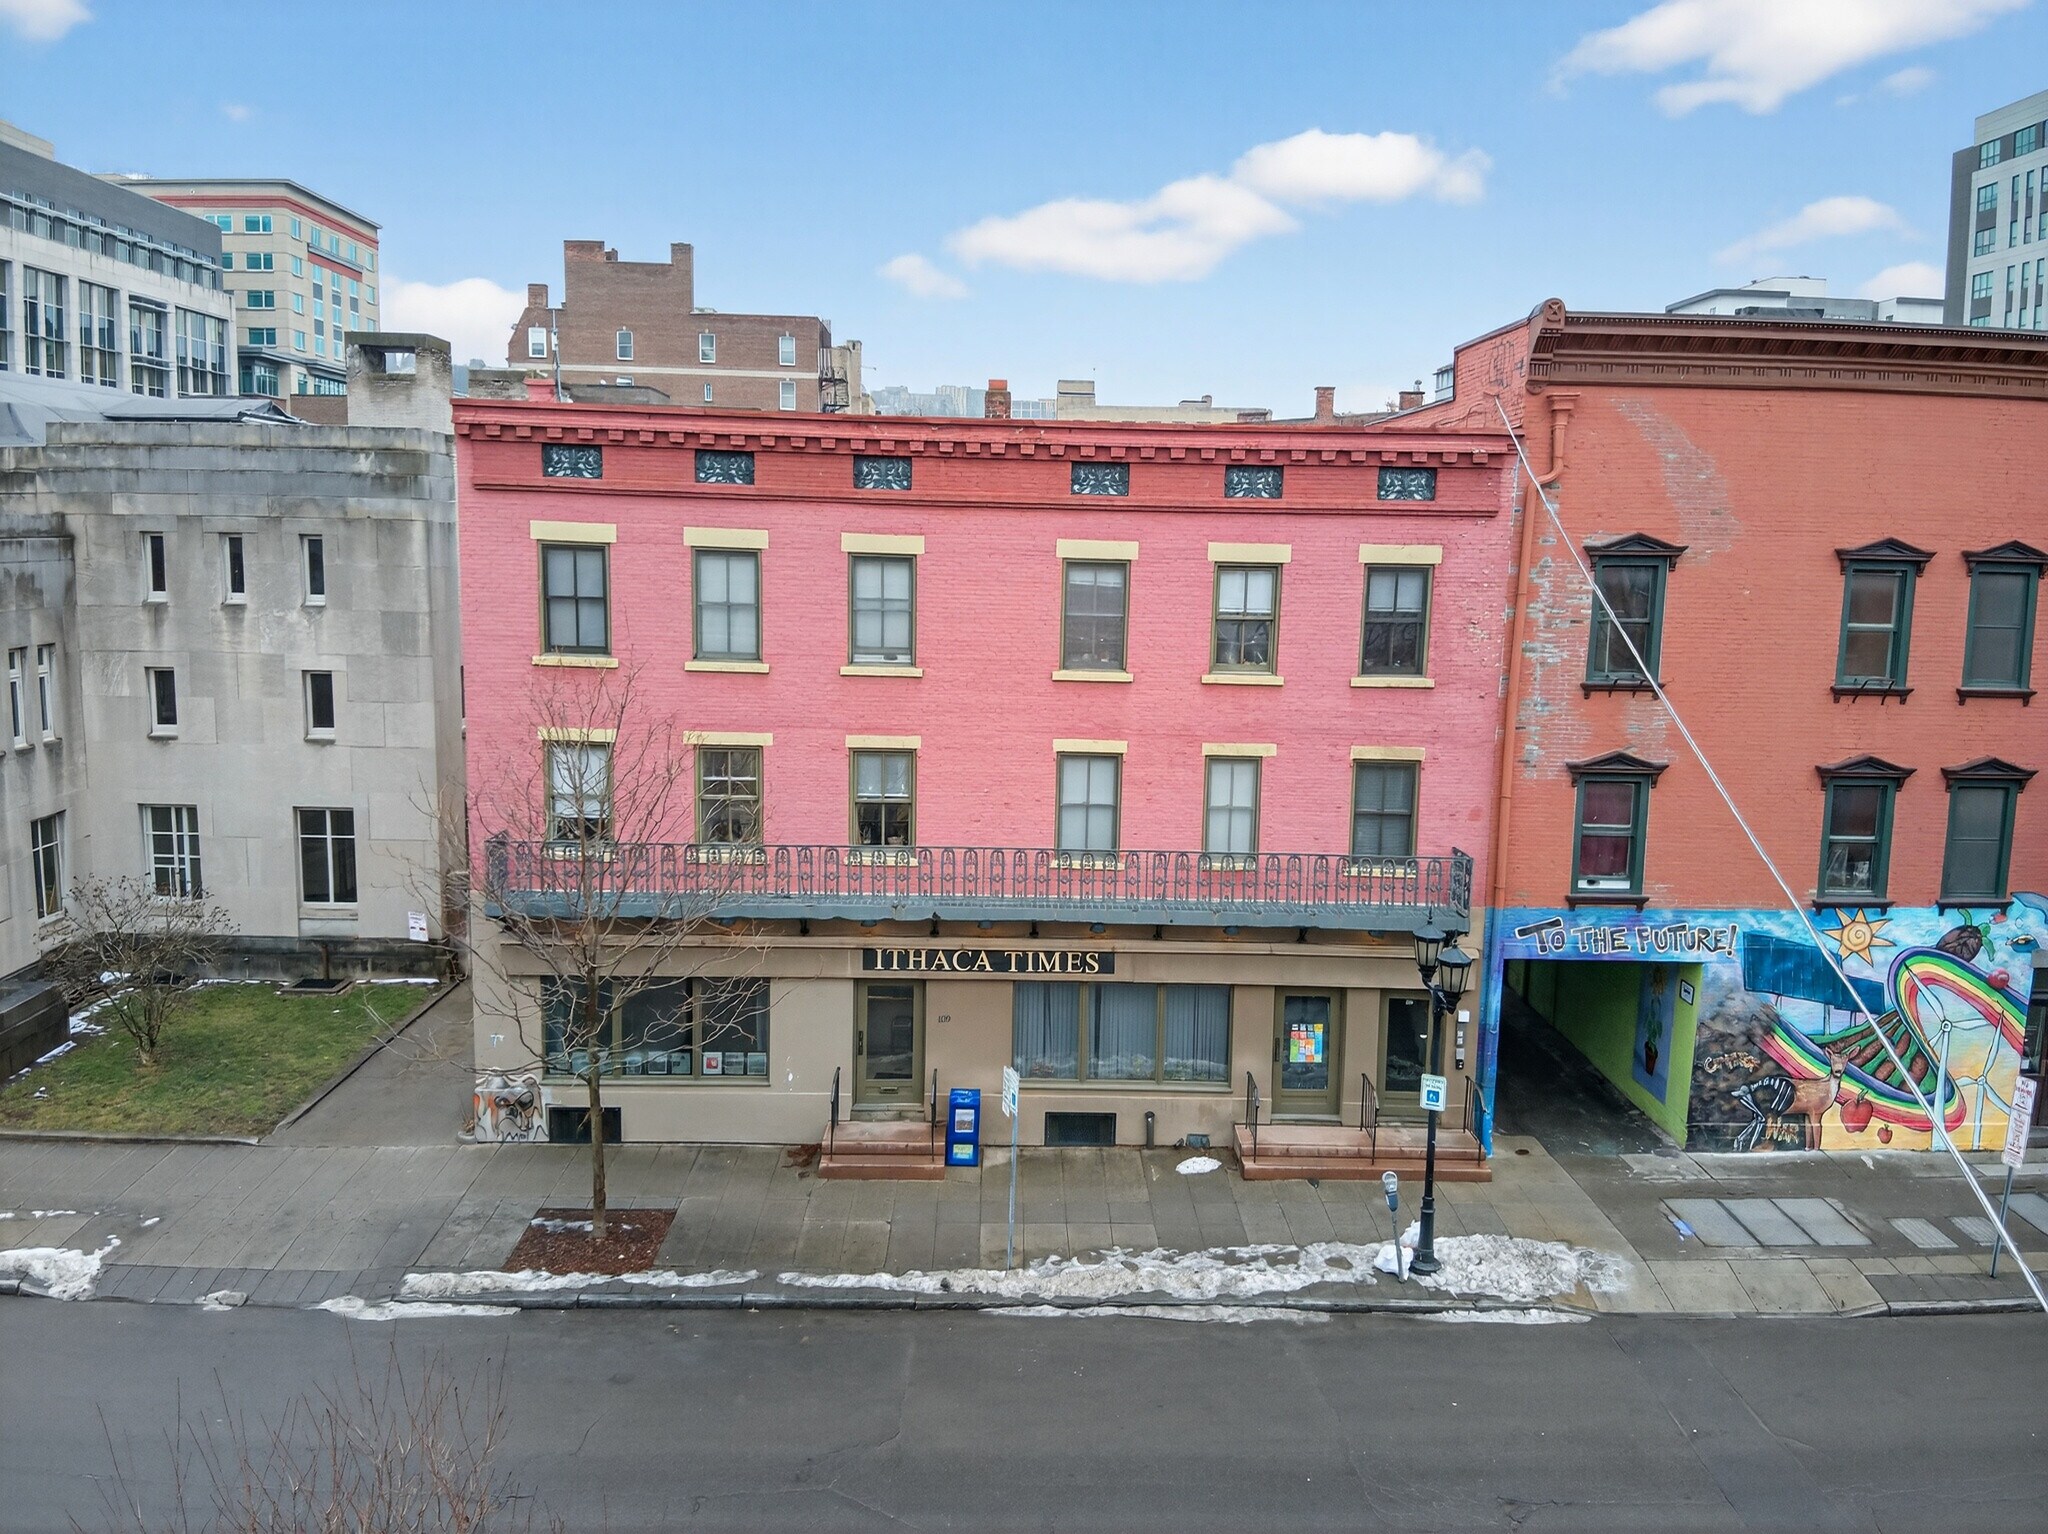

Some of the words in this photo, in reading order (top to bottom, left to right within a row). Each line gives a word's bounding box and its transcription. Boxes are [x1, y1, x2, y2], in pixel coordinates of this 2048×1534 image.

[1571, 925, 1631, 955] THE
[1636, 922, 1738, 958] FUTURE!
[873, 948, 994, 973] ITHACA
[1004, 950, 1100, 974] TIMES
